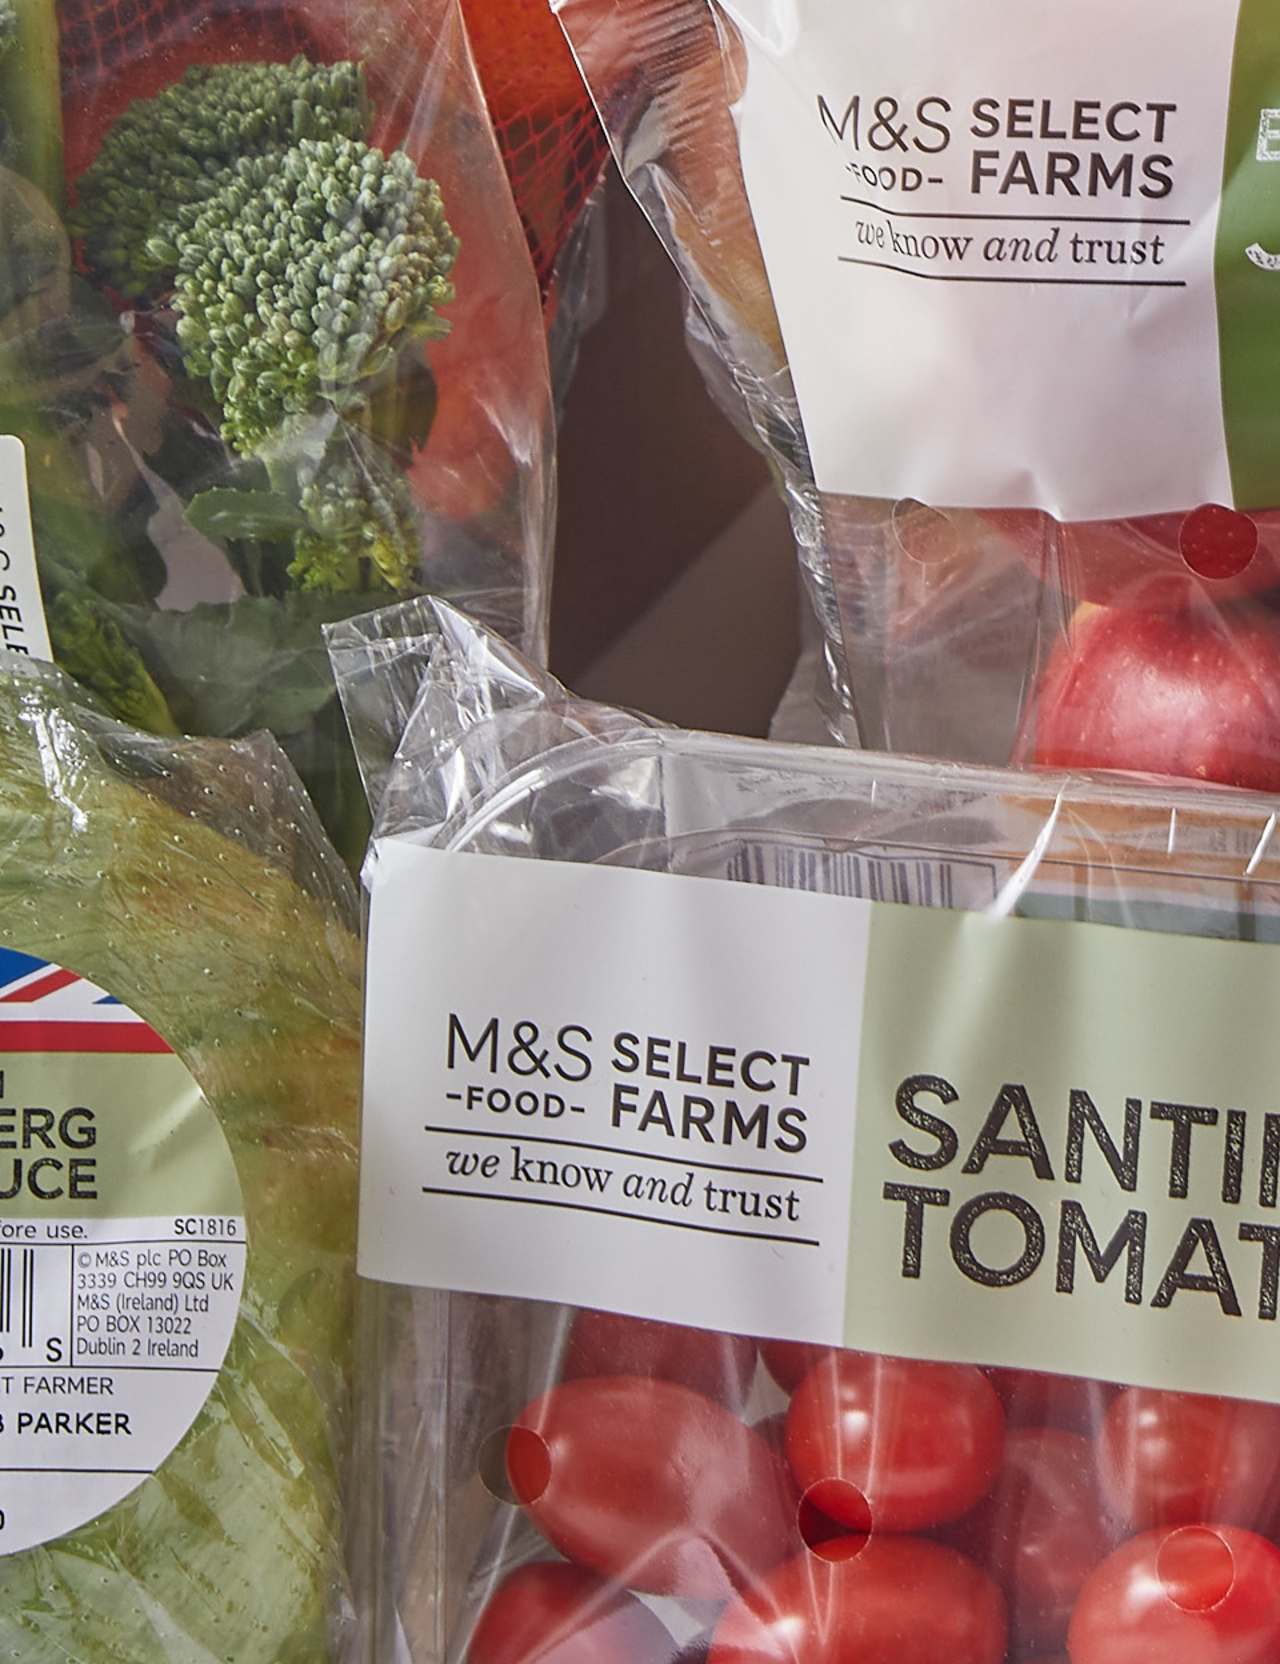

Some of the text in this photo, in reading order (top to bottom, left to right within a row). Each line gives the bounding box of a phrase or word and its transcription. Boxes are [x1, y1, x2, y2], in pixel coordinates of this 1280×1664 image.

[816, 94, 1178, 154] M&S SELECT
[969, 149, 1175, 199] FARMS
[855, 219, 1166, 266] we know and trust
[447, 1013, 810, 1096] M&S SELECT
[611, 1083, 808, 1154] FARMS
[446, 1146, 800, 1222] we know and trust
[46, 1224, 88, 1239] use.
[174, 1218, 237, 1236] SC1816
[96, 1251, 130, 1268] M&S
[136, 1250, 161, 1270] plc
[168, 1249, 192, 1267] PO
[197, 1250, 227, 1268] Box
[77, 1271, 235, 1291] 3339 CH99 9QS UK
[77, 1293, 209, 1315] M&S (Ireland) Ltd
[77, 1315, 192, 1334] PO BOX 13022
[46, 1337, 63, 1362] S
[77, 1338, 199, 1358] Dublin 2 Ireland
[23, 1377, 114, 1395] FARMER
[17, 1412, 132, 1435] PARKER
